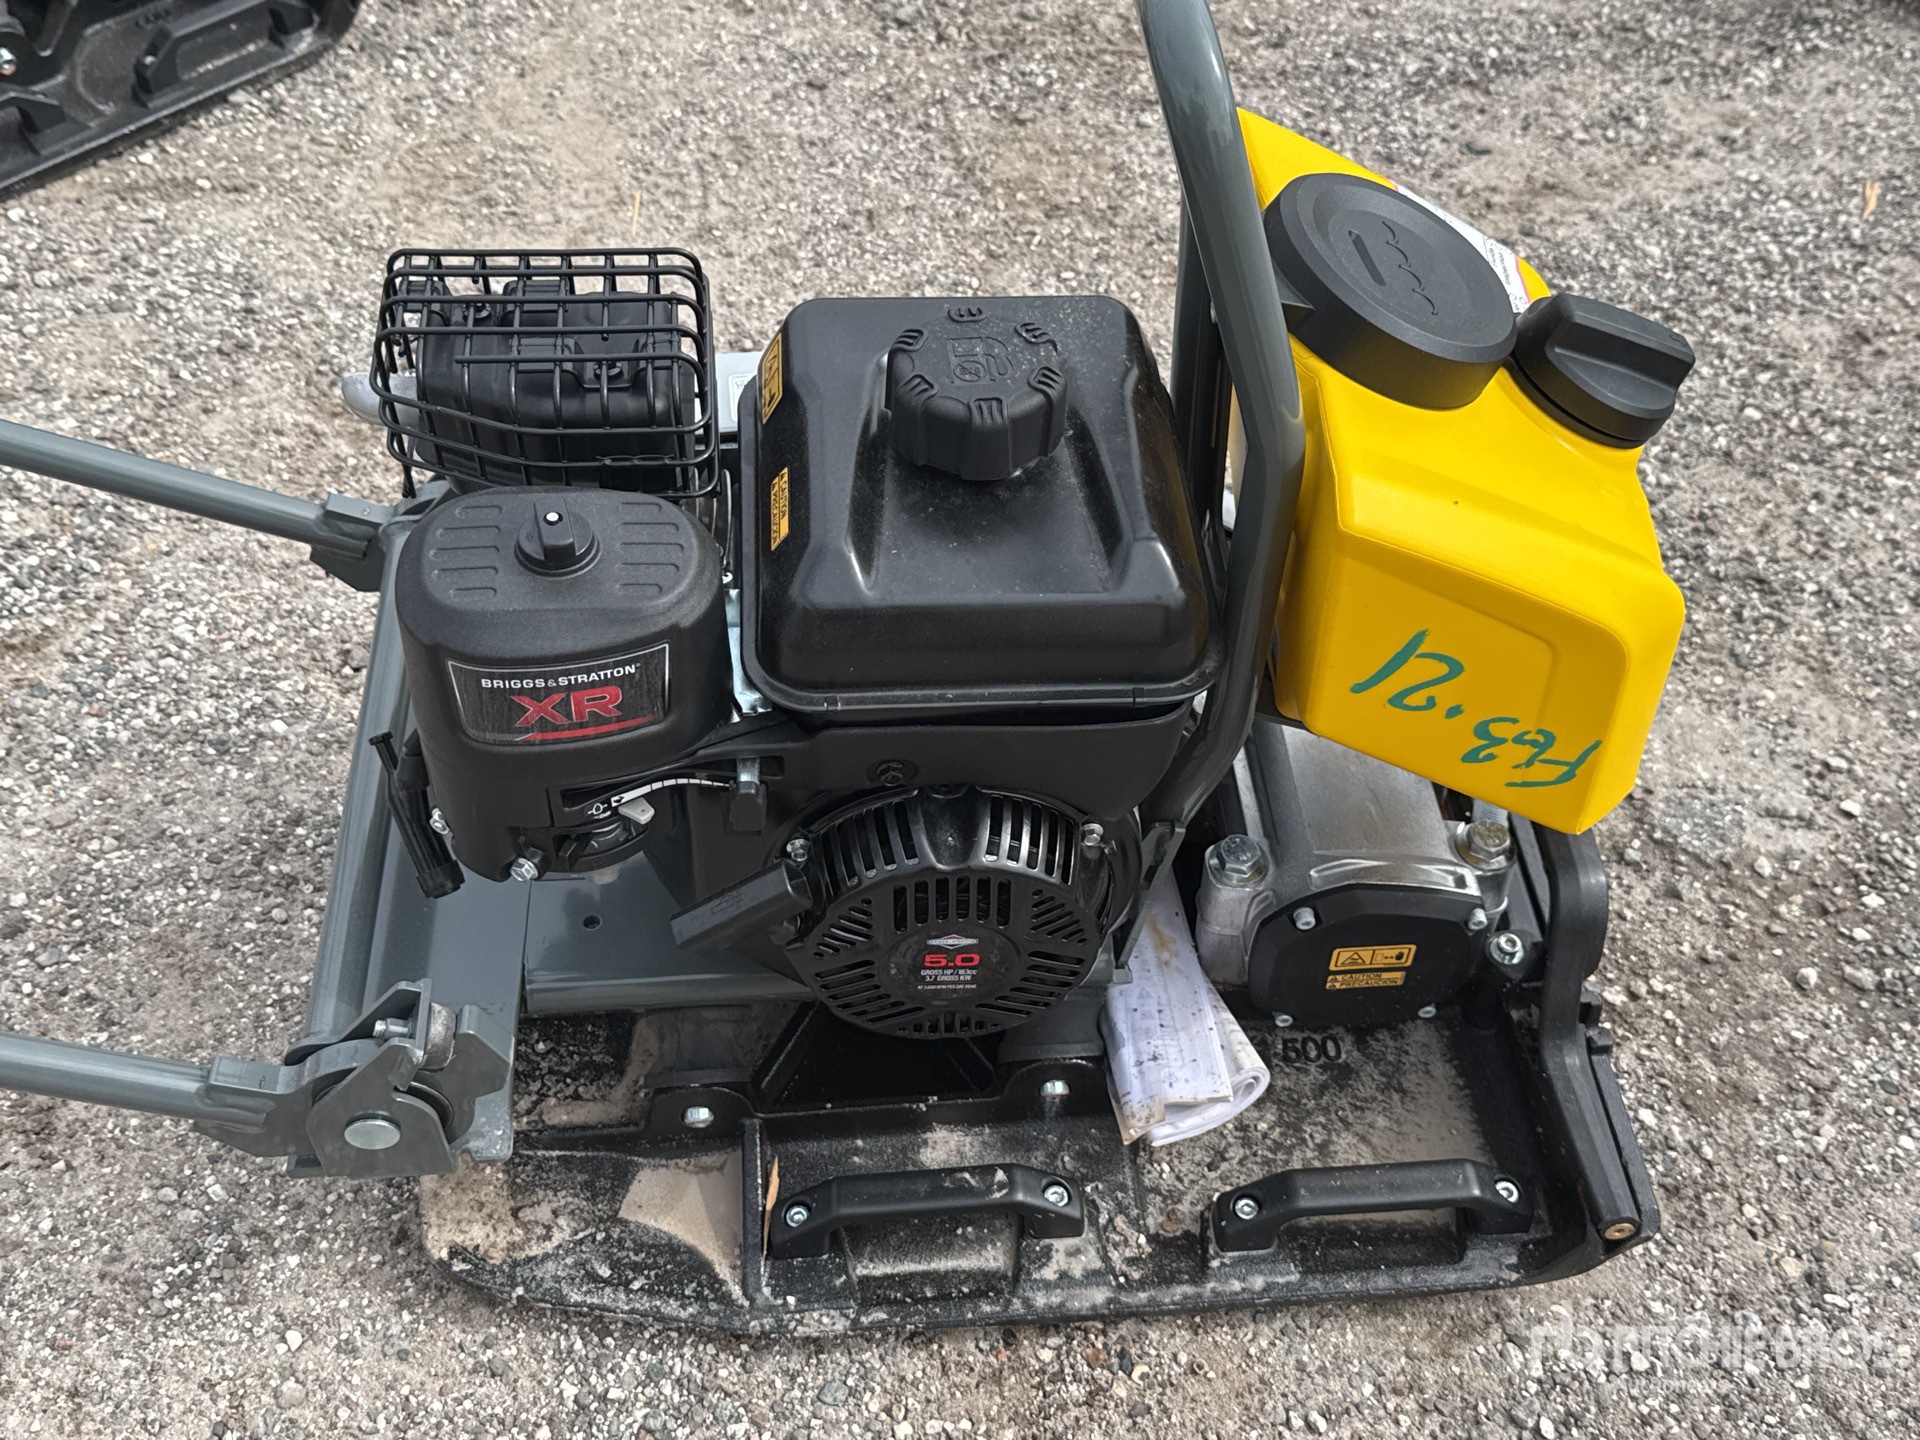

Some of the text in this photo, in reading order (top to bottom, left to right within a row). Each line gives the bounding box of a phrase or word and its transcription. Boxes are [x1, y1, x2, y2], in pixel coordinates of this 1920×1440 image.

[481, 678, 545, 688] BRIGGS
[547, 679, 556, 687] &
[511, 685, 622, 727] XR
[924, 953, 980, 967] 5.0
[1341, 973, 1383, 981] CAUTION
[1282, 1036, 1342, 1063] 500
